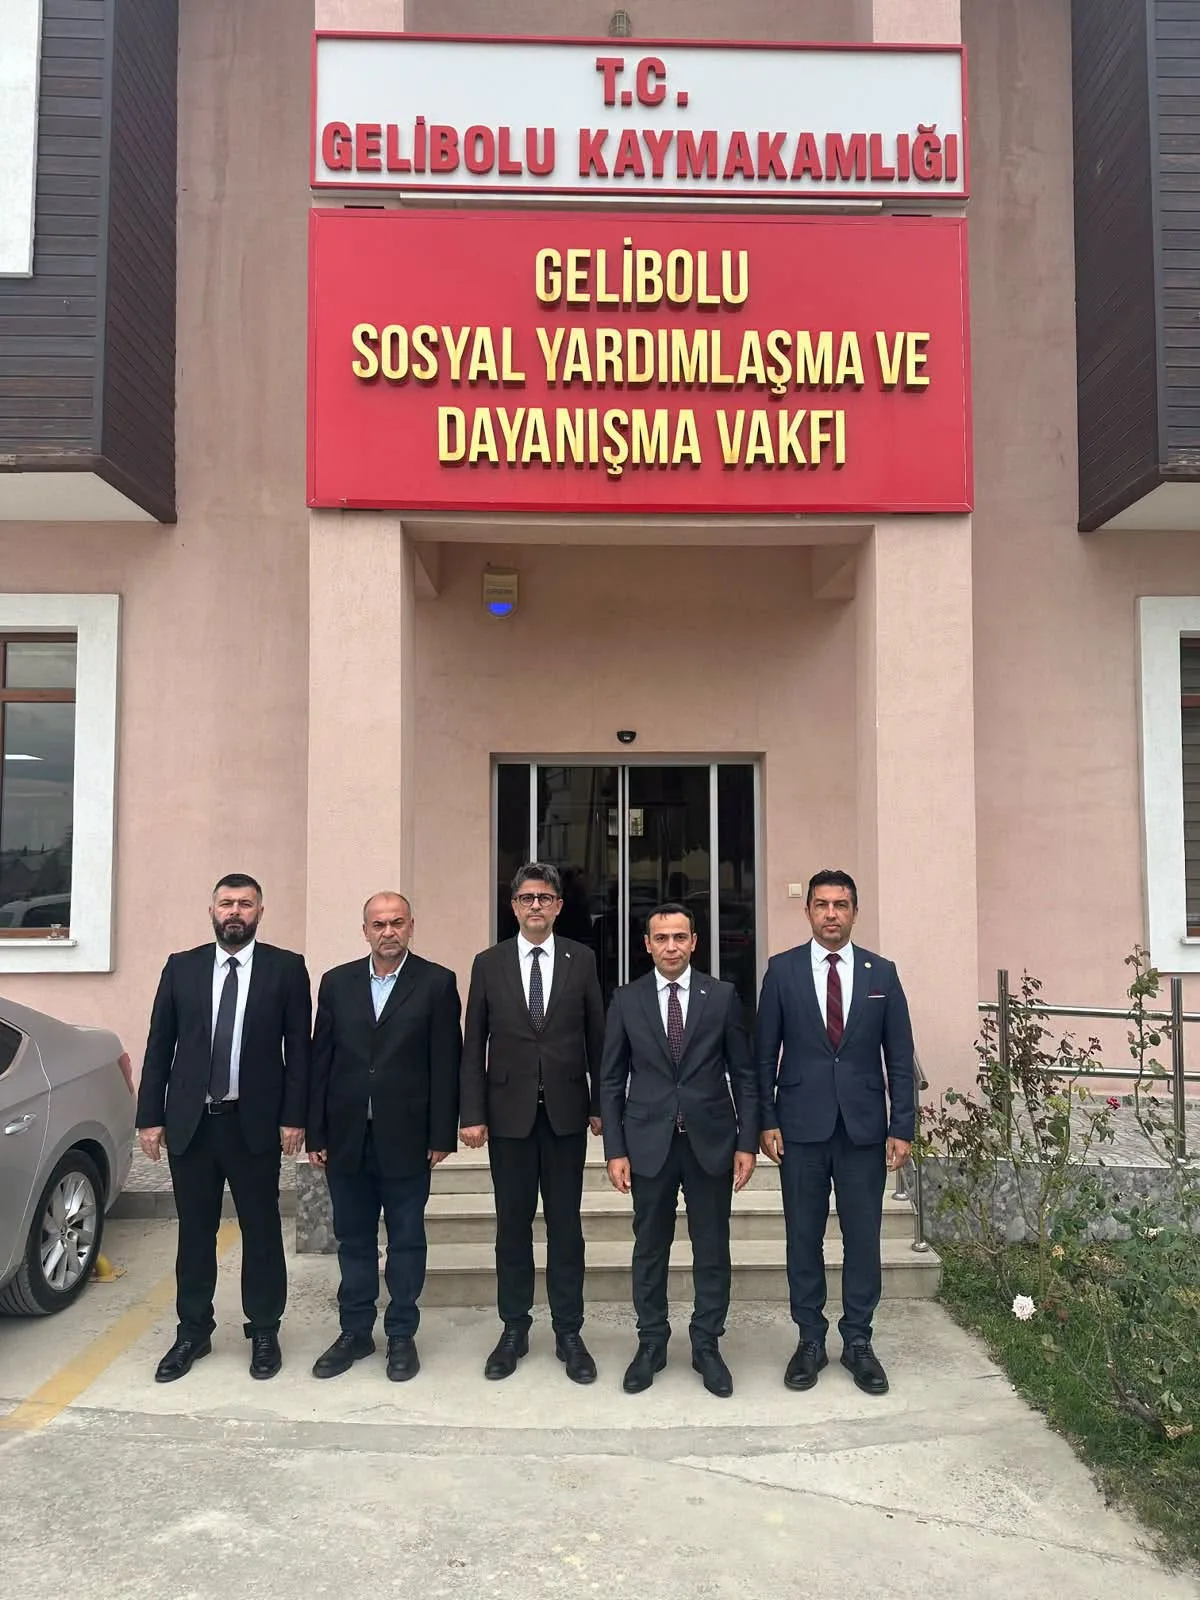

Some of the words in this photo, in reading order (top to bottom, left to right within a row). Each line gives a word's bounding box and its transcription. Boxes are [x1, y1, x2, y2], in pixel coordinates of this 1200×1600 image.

[322, 115, 556, 176] GELİBOLU
[578, 123, 959, 182] KAYMAKAMLIĞI
[534, 236, 750, 304] GELİBOLU
[351, 322, 526, 383] SOSYAL
[535, 326, 865, 395] YARDIMLAŞMA
[875, 329, 931, 386] VE
[436, 405, 702, 476] DAYANIŞMA
[715, 408, 847, 466] VAKFI
